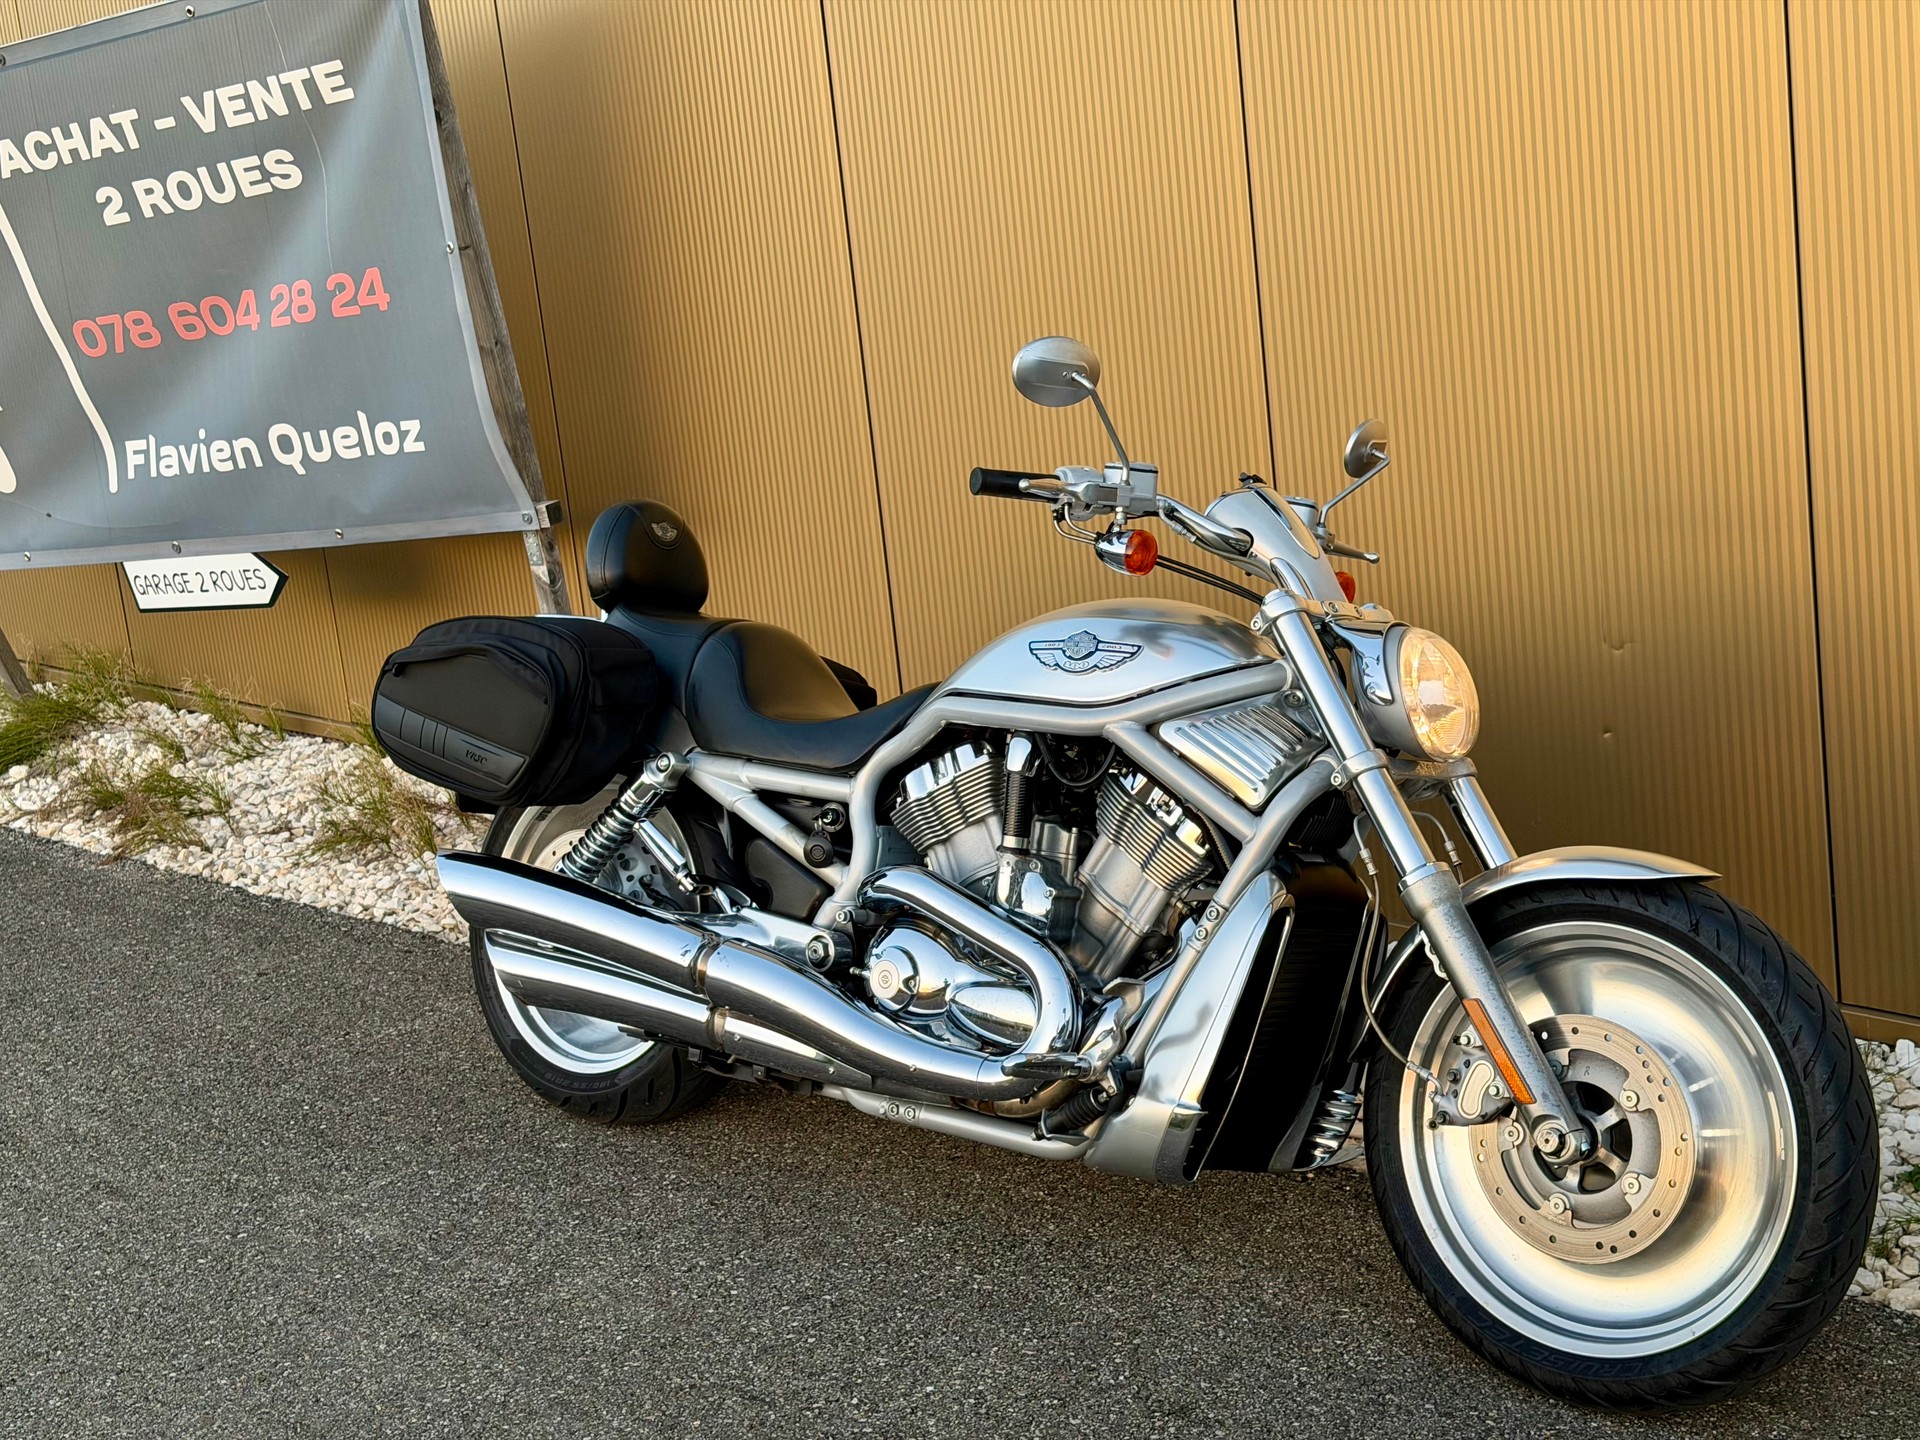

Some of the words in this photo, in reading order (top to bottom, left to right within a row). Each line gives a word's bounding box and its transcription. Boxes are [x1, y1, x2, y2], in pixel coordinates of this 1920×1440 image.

[0, 108, 140, 179] ACHAT
[154, 116, 176, 130] -
[180, 59, 355, 133] VENTE
[95, 186, 131, 226] 2
[131, 149, 303, 218] ROUES
[72, 310, 162, 358] 078
[168, 289, 260, 340] 604
[270, 279, 317, 328] 28
[326, 267, 390, 317] 24
[125, 428, 263, 480] Flavien
[268, 410, 425, 475] Queloz
[133, 572, 194, 596] GARAGE
[195, 572, 209, 593] 2
[209, 568, 267, 593] ROUES
[1466, 1312, 1643, 1376] CRUISETEC
